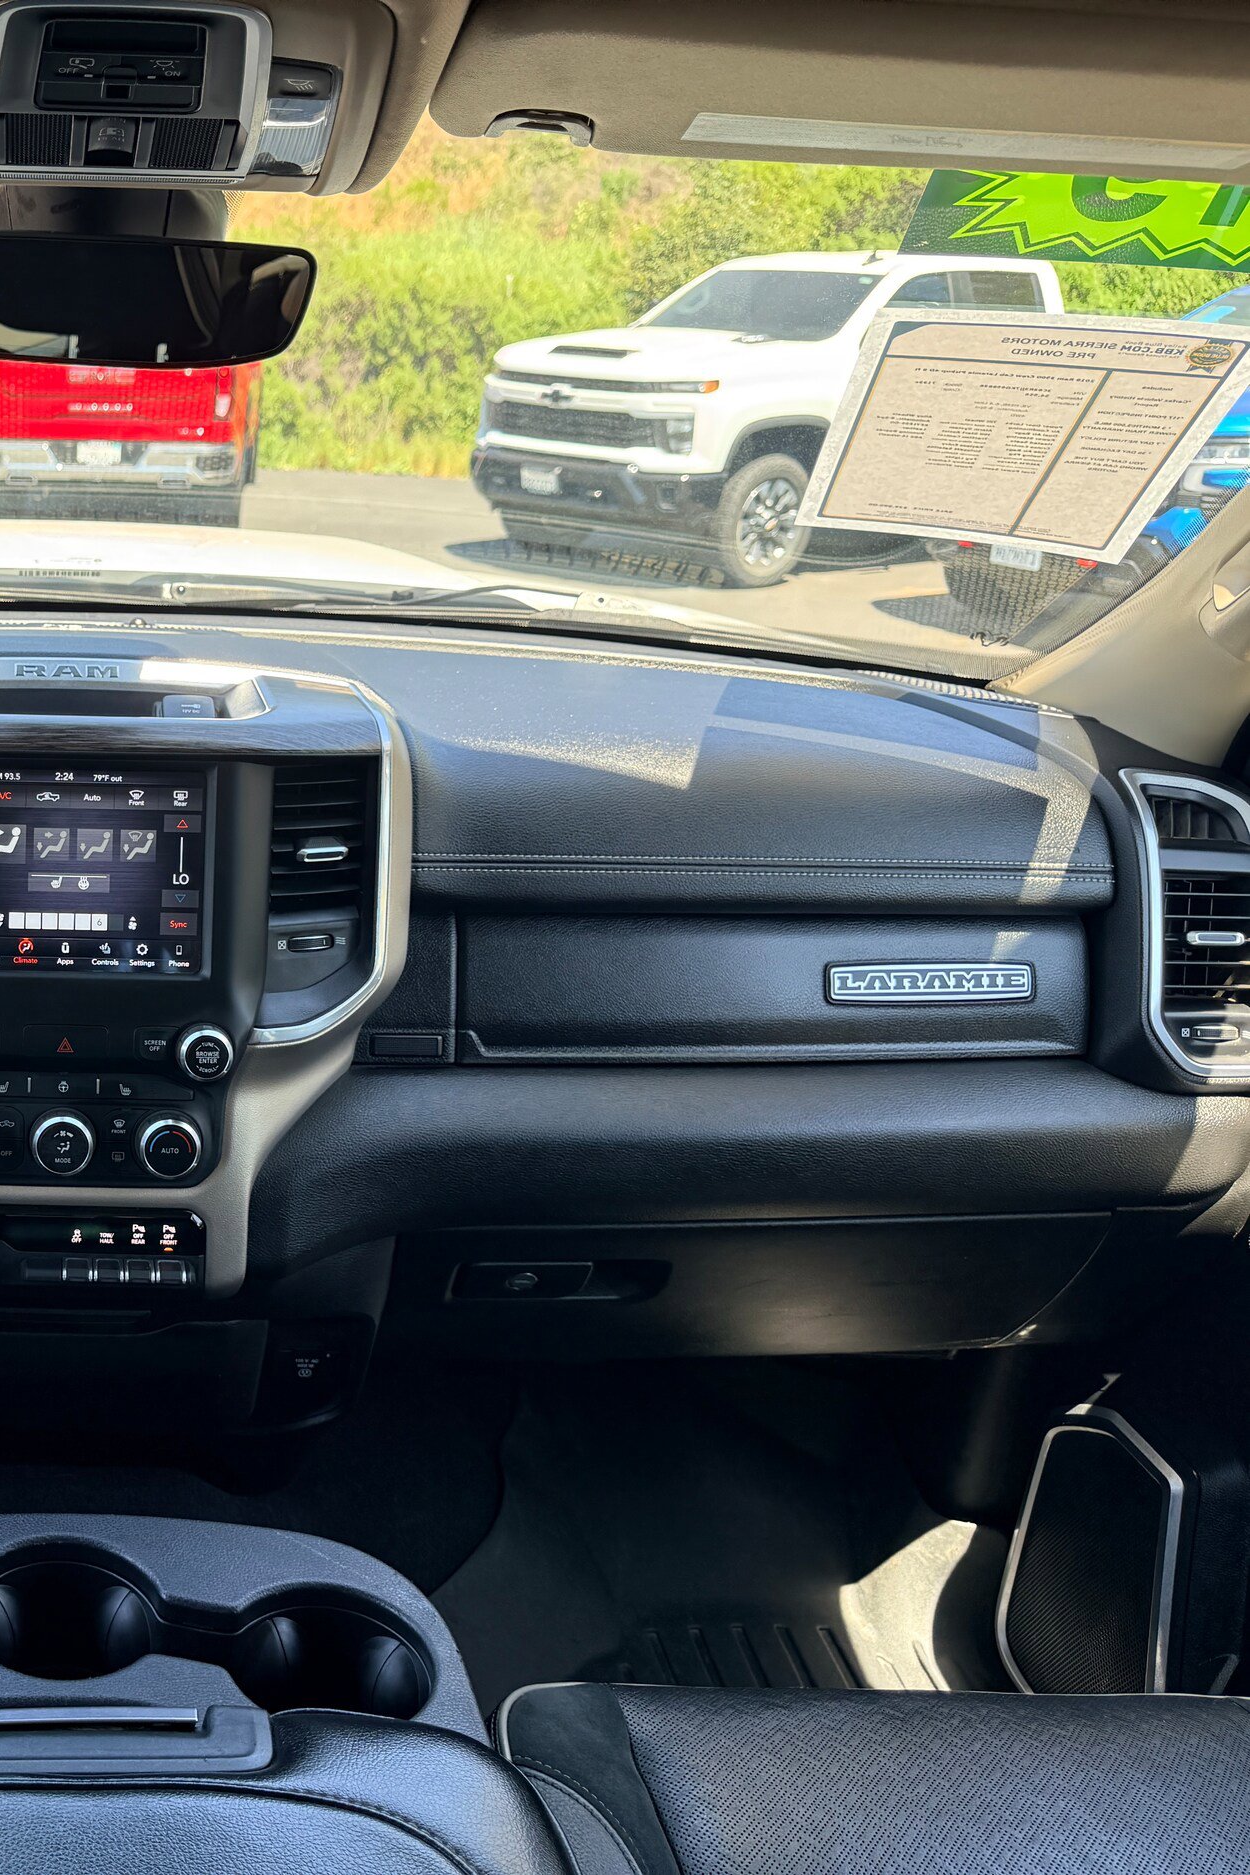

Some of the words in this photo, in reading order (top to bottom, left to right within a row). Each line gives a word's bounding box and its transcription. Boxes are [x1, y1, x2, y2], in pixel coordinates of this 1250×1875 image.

[14, 663, 119, 679] RAM
[4, 772, 21, 781] 93.5
[55, 772, 74, 781] 2:24
[83, 793, 101, 802] Auto
[128, 799, 145, 807] Front
[172, 874, 190, 885] LO
[97, 918, 103, 926] 6
[170, 920, 187, 930] Sync
[13, 956, 38, 965] Climate
[57, 957, 74, 967] Apps
[91, 957, 119, 966] Controls
[129, 959, 155, 968] Settings
[168, 959, 190, 968] Phone
[834, 971, 1029, 994] LARAMIE
[144, 1039, 166, 1047] SCREEN
[161, 1147, 180, 1155] AUTO
